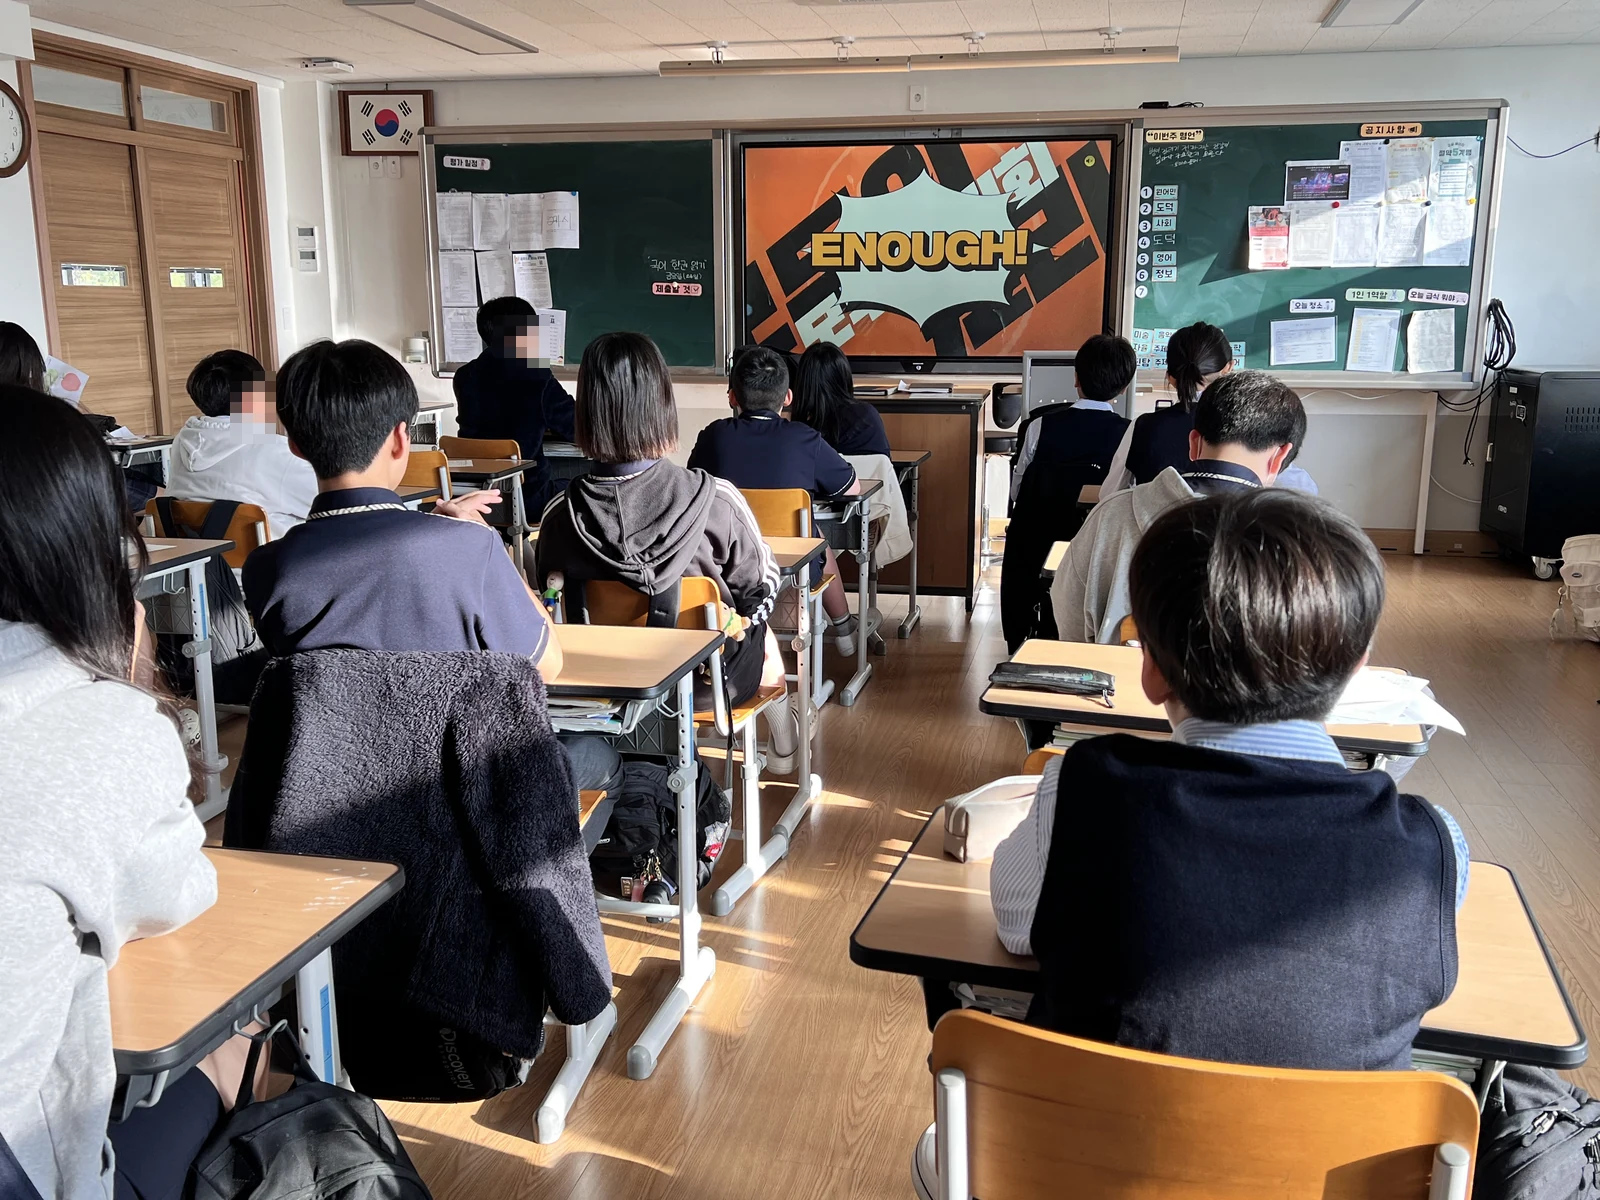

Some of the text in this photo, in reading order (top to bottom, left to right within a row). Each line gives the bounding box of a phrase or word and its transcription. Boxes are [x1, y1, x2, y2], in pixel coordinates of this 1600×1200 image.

[1156, 202, 1174, 212] 도덕
[1155, 218, 1172, 227] 사회
[1153, 233, 1176, 245] 도덕
[810, 229, 1029, 272] ENOUGH!
[1156, 253, 1172, 263] 영어
[1155, 269, 1173, 279] 정보
